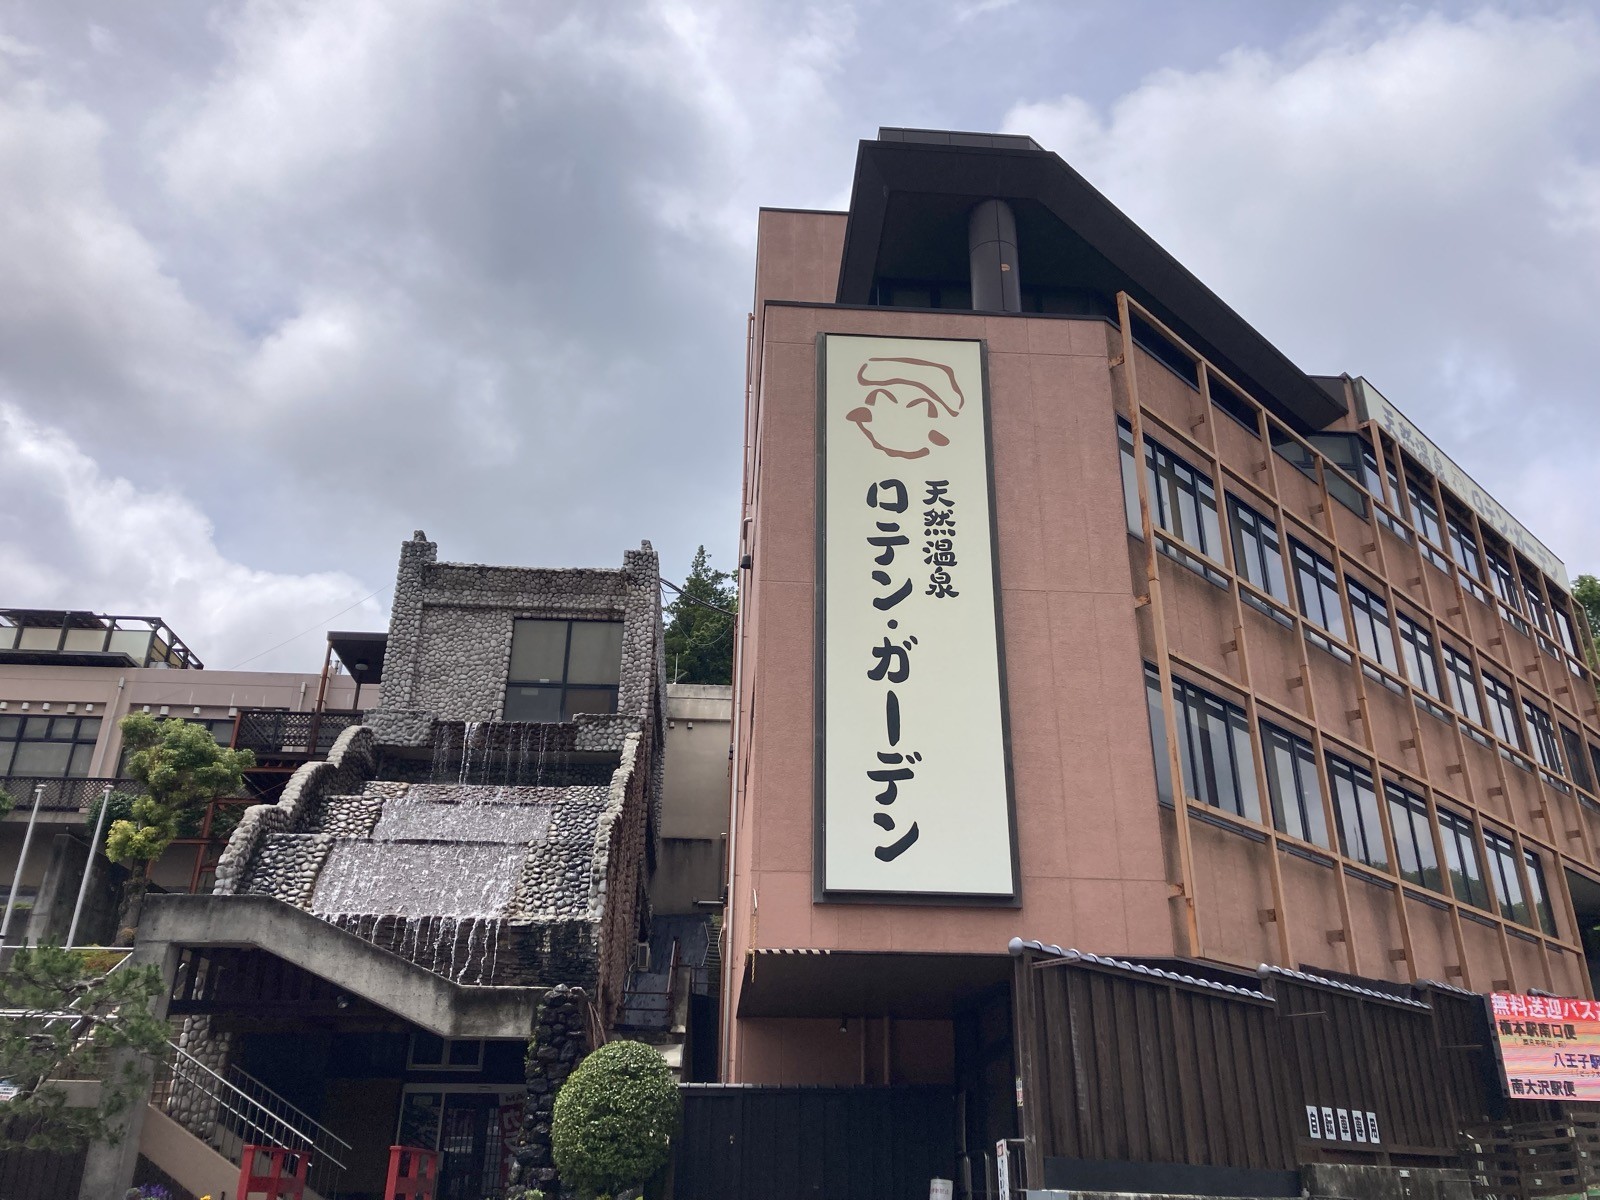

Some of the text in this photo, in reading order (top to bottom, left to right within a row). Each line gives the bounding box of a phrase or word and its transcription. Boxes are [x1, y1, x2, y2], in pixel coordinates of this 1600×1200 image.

[1381, 404, 1449, 485] 天然温泉
[922, 479, 960, 599] 天然温泉
[866, 478, 923, 863] ロテン・ガーデン
[1499, 1019, 1577, 1040] 橋本駅南口便
[1510, 1078, 1577, 1097] 南大沢駅便
